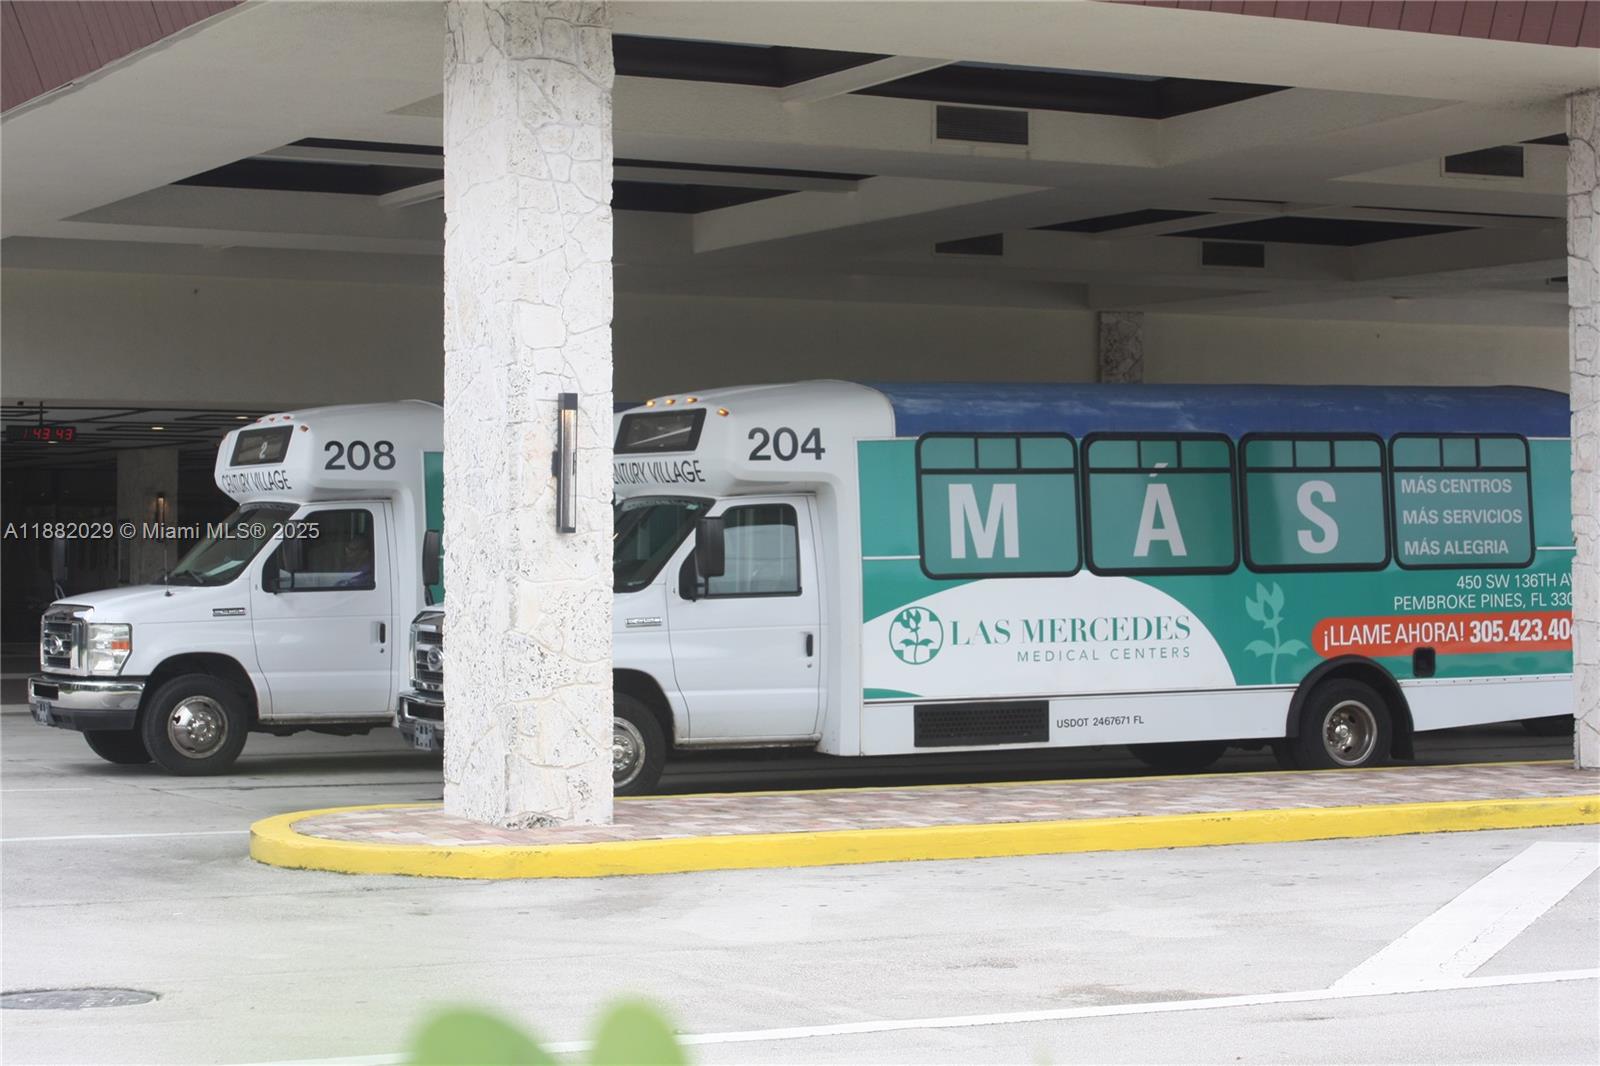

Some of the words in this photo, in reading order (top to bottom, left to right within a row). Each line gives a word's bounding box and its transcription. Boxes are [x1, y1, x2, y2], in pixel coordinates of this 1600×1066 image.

[748, 427, 826, 461] 204
[323, 440, 396, 471] 208
[250, 469, 293, 492] VILLAGE
[647, 460, 706, 484] VILLAGE
[1401, 475, 1437, 494] MÁS
[1440, 478, 1513, 494] CENTROS
[1403, 506, 1439, 525] MÁS
[1442, 508, 1523, 524] SERVICIOS
[1404, 537, 1440, 556] MÁS
[1444, 539, 1509, 555] ALEGRIA
[1457, 575, 1482, 590] 450
[1486, 574, 1510, 589] SW
[1515, 572, 1557, 588] 136TH
[1394, 594, 1476, 611] PEMBROKE
[1481, 592, 1526, 609] PINES,
[1531, 591, 1547, 607] FL
[949, 619, 1011, 646] LAS
[1021, 615, 1191, 644] MERCEDES
[1395, 620, 1464, 644] AHORA!
[1469, 617, 1573, 643] 305.423.40
[1017, 648, 1099, 662] MEDICAL
[1110, 646, 1191, 660] CENTERS
[1056, 717, 1090, 729] USDOT
[1092, 715, 1131, 727] 2467671
[1133, 714, 1145, 725] FL
